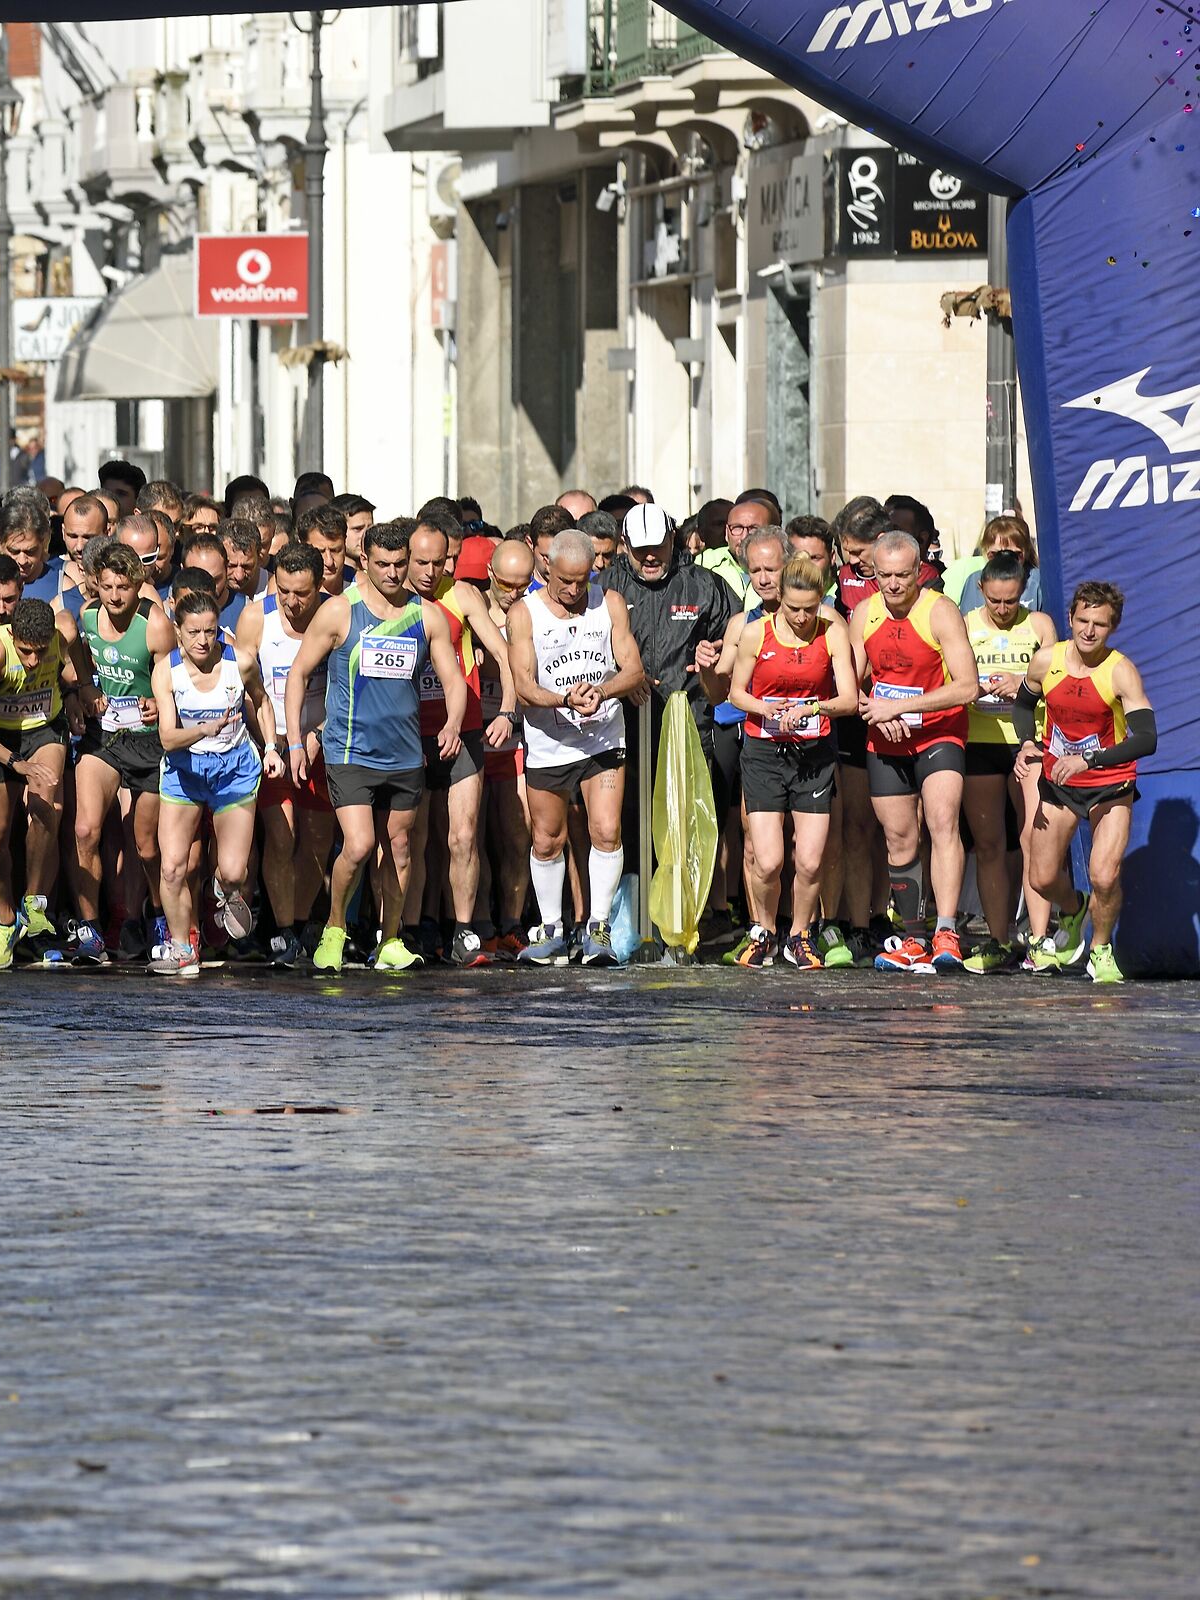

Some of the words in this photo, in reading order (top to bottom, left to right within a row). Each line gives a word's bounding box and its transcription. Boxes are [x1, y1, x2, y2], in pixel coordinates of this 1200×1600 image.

[852, 231, 880, 245] 1982
[911, 230, 978, 249] BULOVA
[210, 283, 298, 303] vodafone
[374, 652, 405, 669] 265
[545, 650, 607, 675] PODISTICA
[976, 653, 1031, 664] AIELLO
[555, 670, 602, 687] CIAMPINO
[3, 702, 43, 714] IDAM
[112, 710, 121, 723] 2
